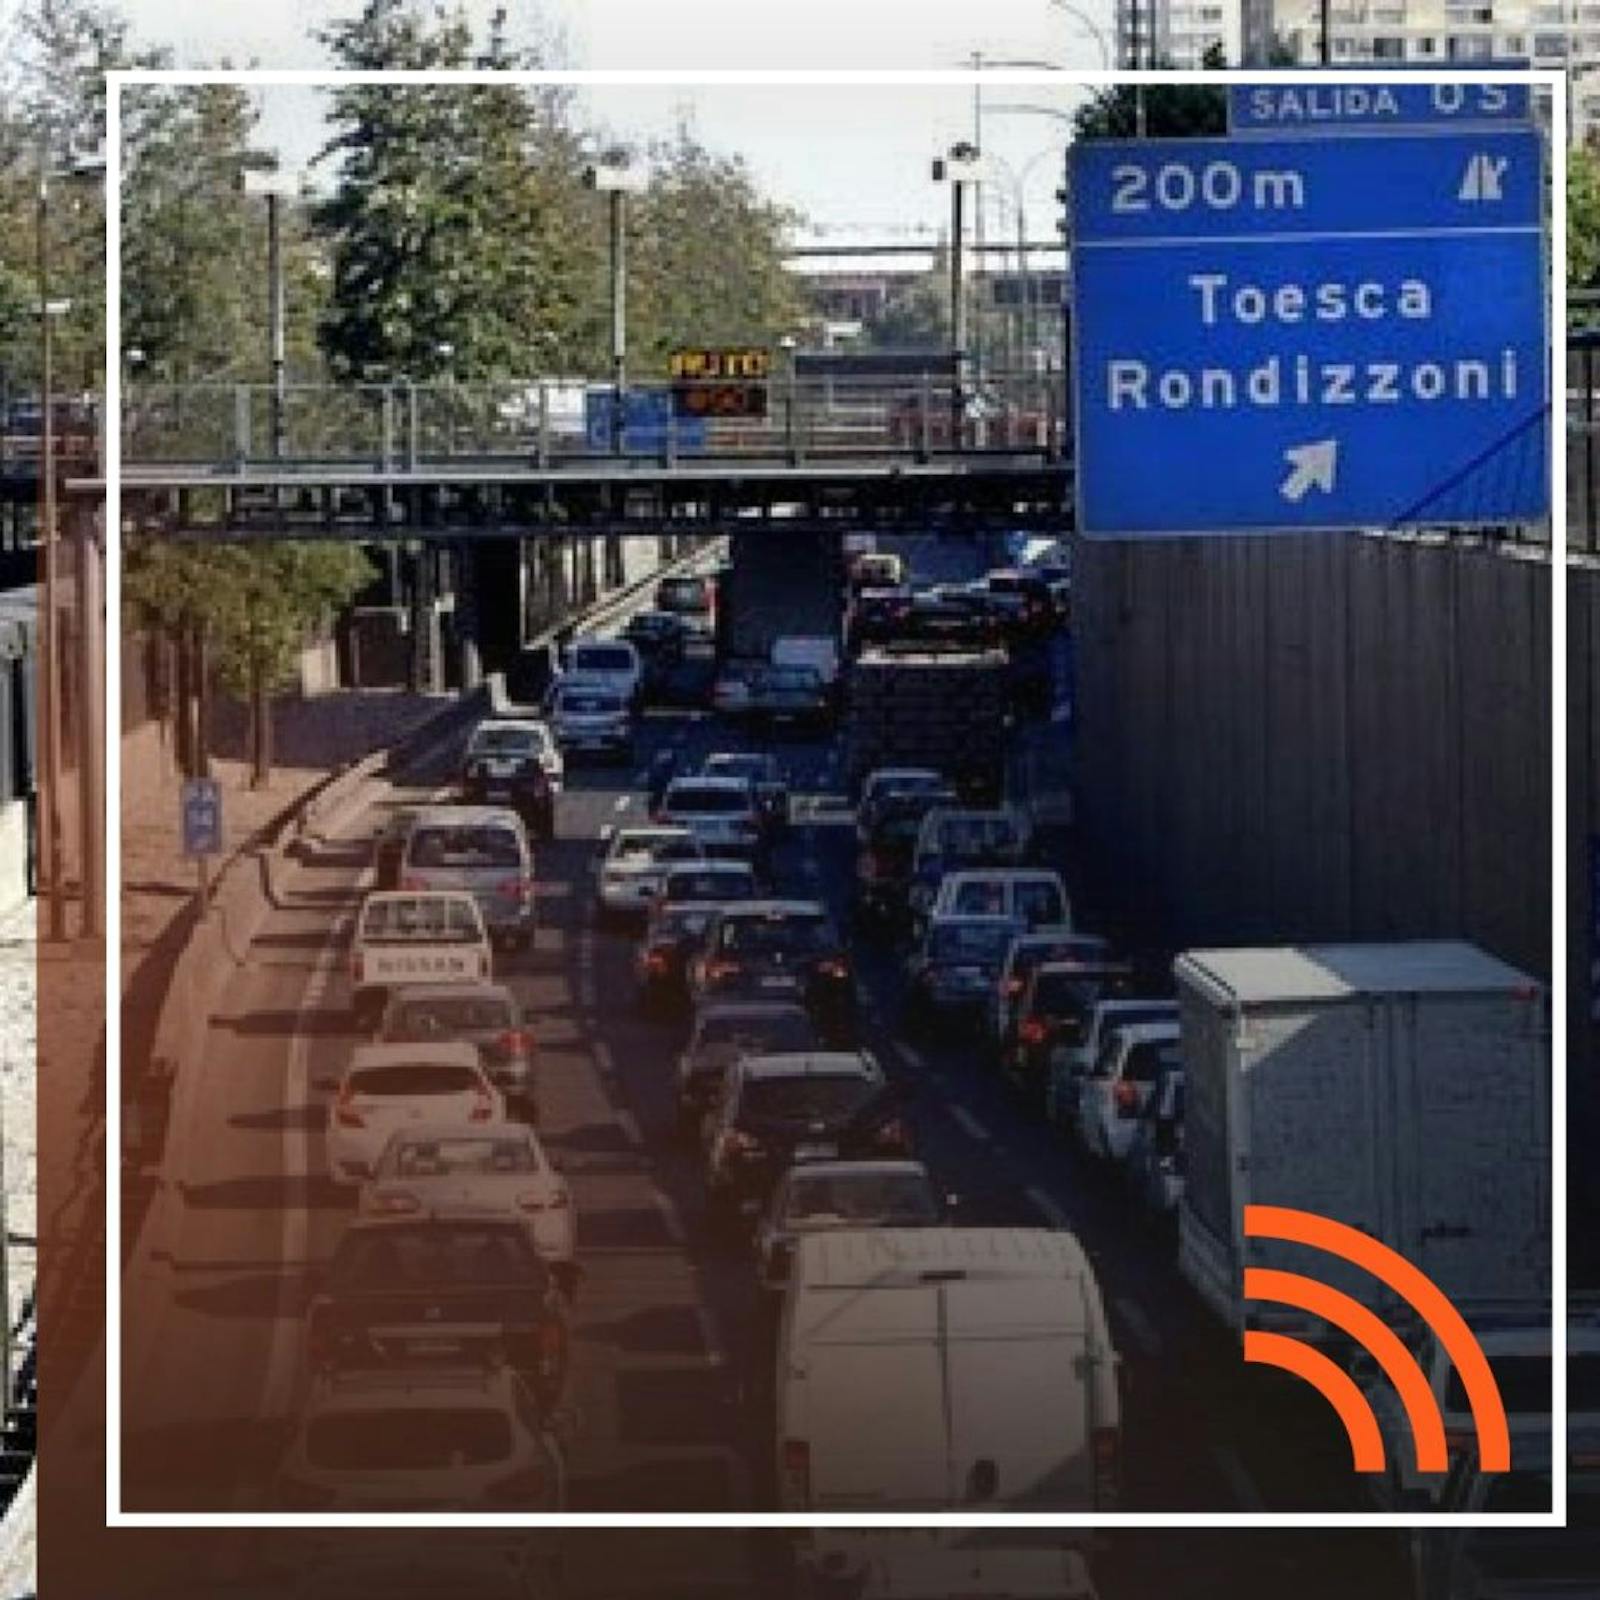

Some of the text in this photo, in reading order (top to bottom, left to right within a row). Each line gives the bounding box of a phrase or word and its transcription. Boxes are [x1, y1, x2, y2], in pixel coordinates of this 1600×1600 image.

[1251, 87, 1399, 120] SALIDA
[1188, 274, 1432, 325] Toesca
[1107, 348, 1517, 411] Rondizzoni
